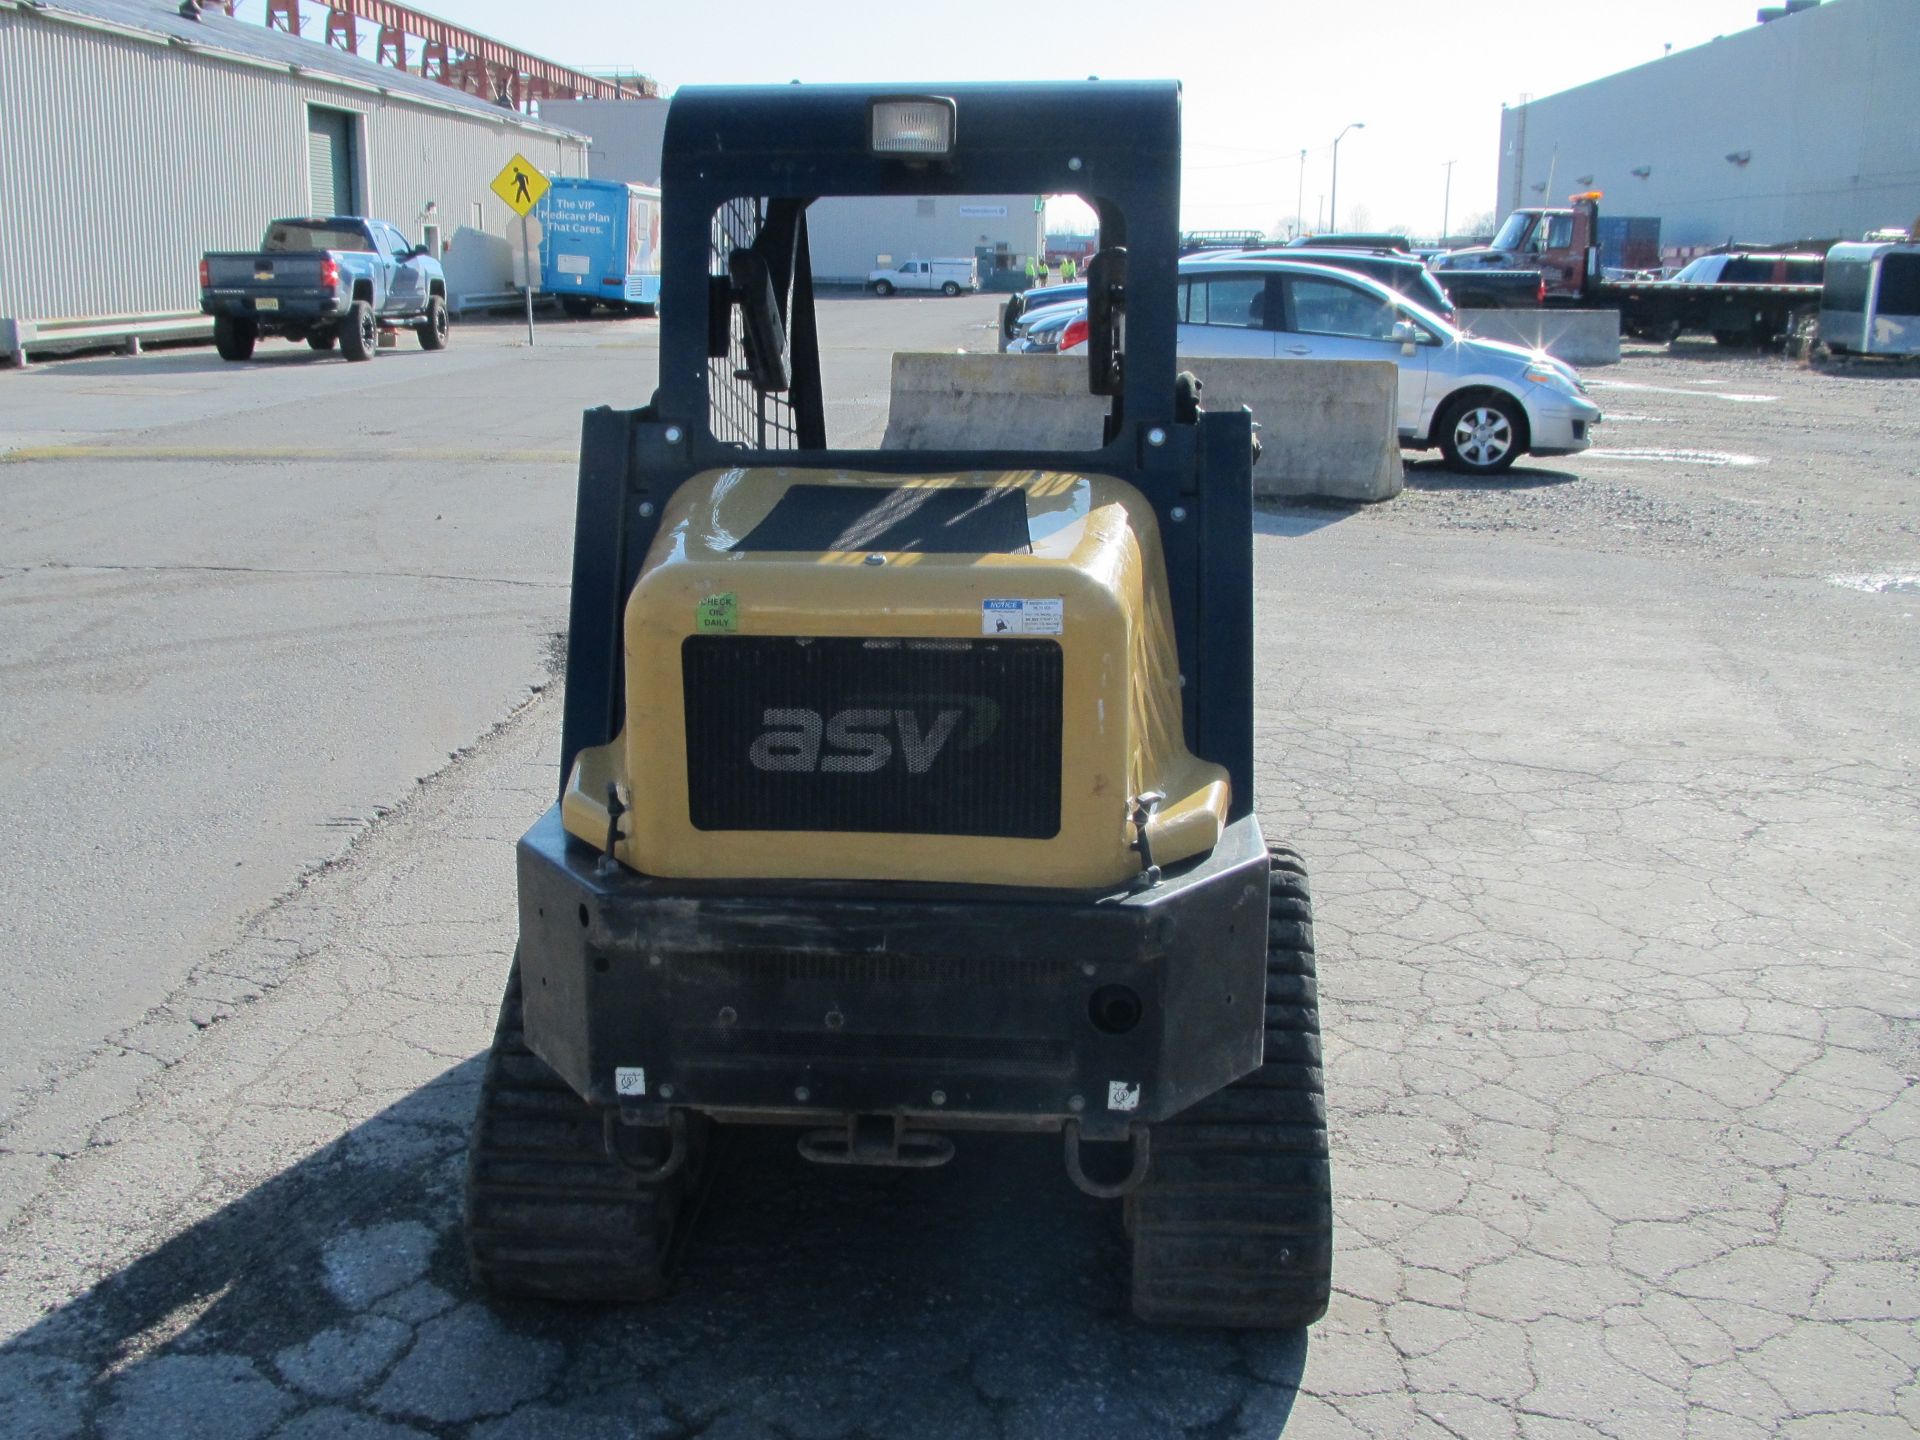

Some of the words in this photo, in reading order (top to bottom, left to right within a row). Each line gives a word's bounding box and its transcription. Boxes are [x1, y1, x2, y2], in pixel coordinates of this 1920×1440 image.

[557, 199, 576, 209] The
[577, 200, 596, 210] VIP
[541, 210, 586, 221] Medicare
[588, 212, 610, 223] Plan
[549, 222, 571, 232] That
[573, 224, 604, 234] Cares.
[990, 601, 1018, 609] NOTICE
[708, 608, 725, 617] OIL
[704, 618, 729, 627] DAILY
